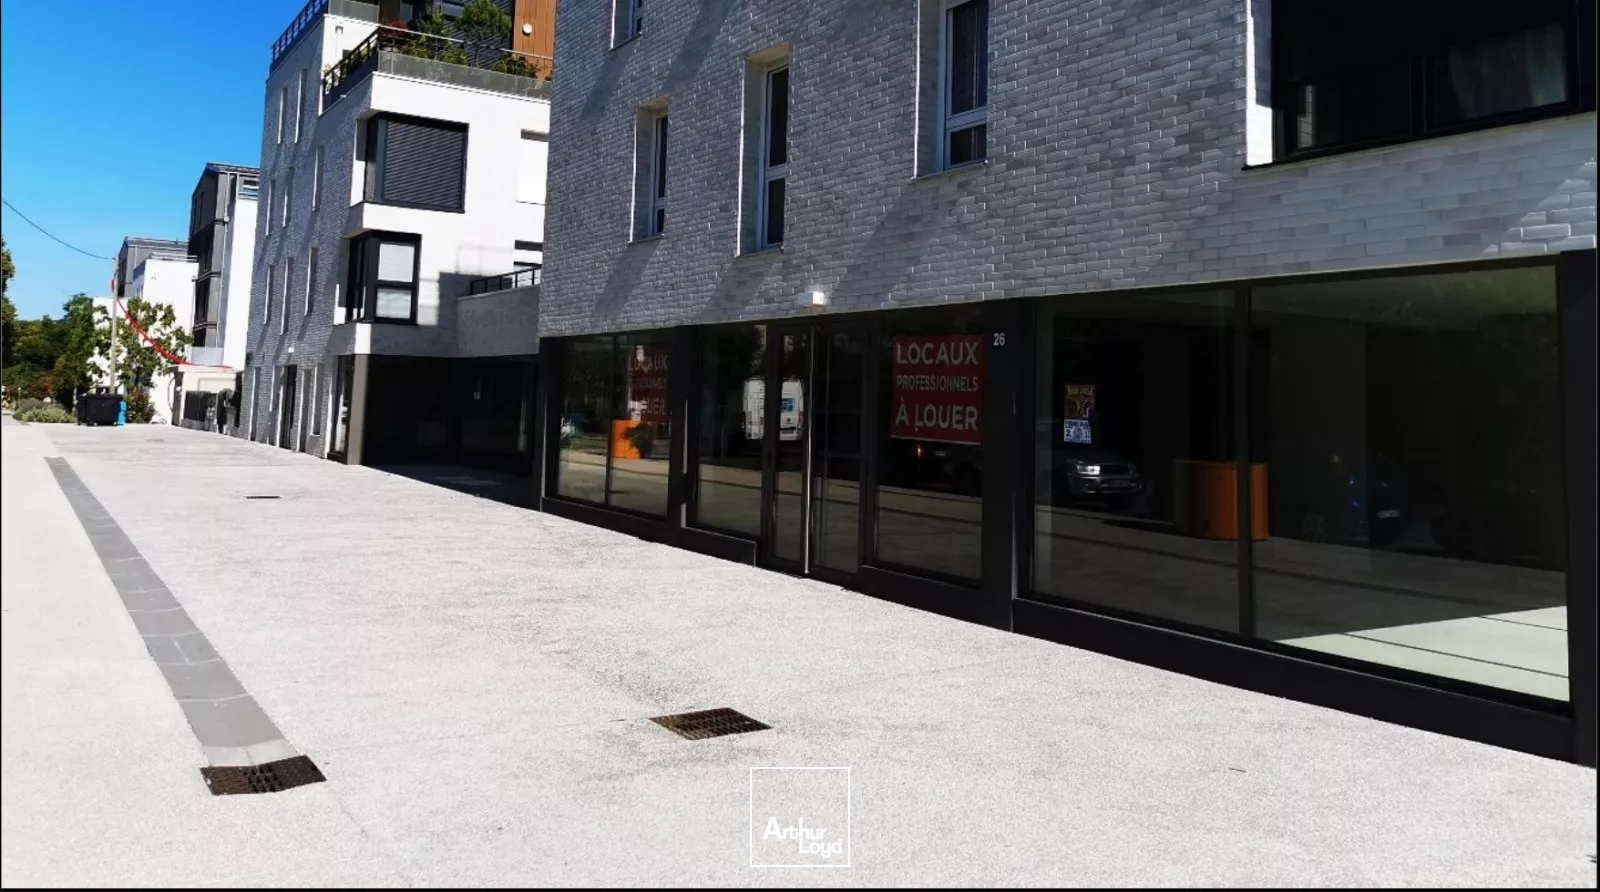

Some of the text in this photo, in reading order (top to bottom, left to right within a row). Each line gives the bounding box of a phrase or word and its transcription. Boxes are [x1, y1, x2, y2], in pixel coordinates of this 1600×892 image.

[993, 332, 1006, 346] 26
[896, 341, 979, 365] LOCAUX
[896, 374, 979, 392] PROFESSIONNELS
[895, 396, 978, 430] À LOUER
